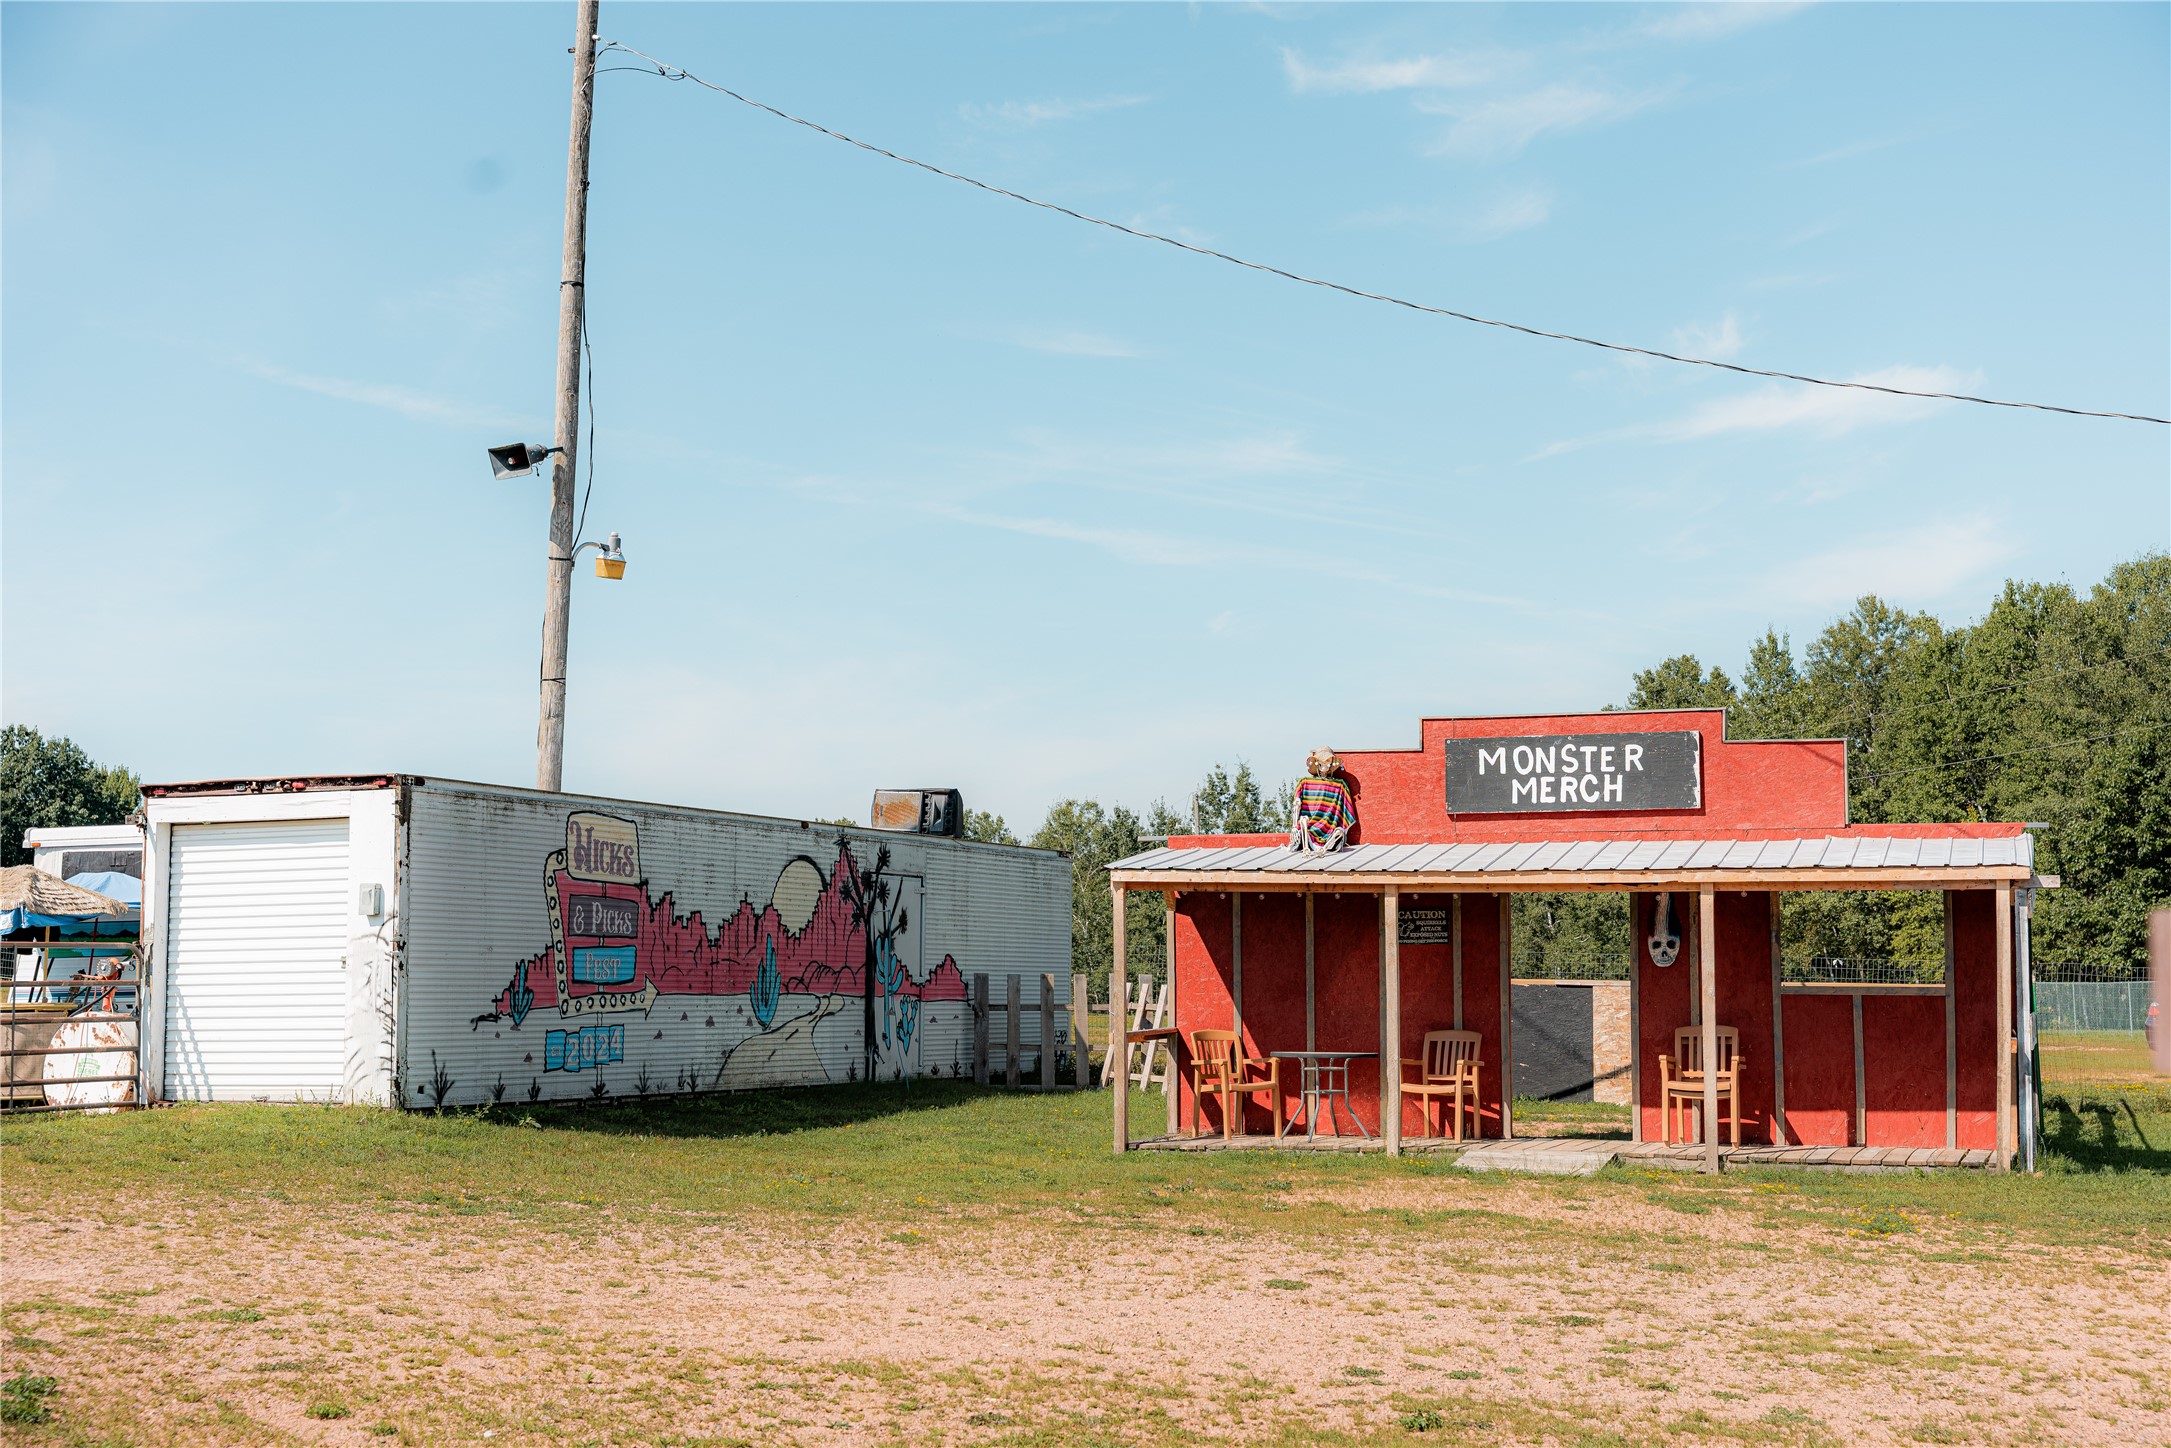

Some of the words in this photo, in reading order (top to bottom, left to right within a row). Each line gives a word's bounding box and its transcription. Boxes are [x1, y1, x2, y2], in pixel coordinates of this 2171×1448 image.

[1478, 744, 1644, 775] MONSTER
[1512, 774, 1623, 804] MERCH
[573, 905, 585, 934] &
[1398, 910, 1446, 919] CAUTION
[566, 1027, 622, 1067] 2024
